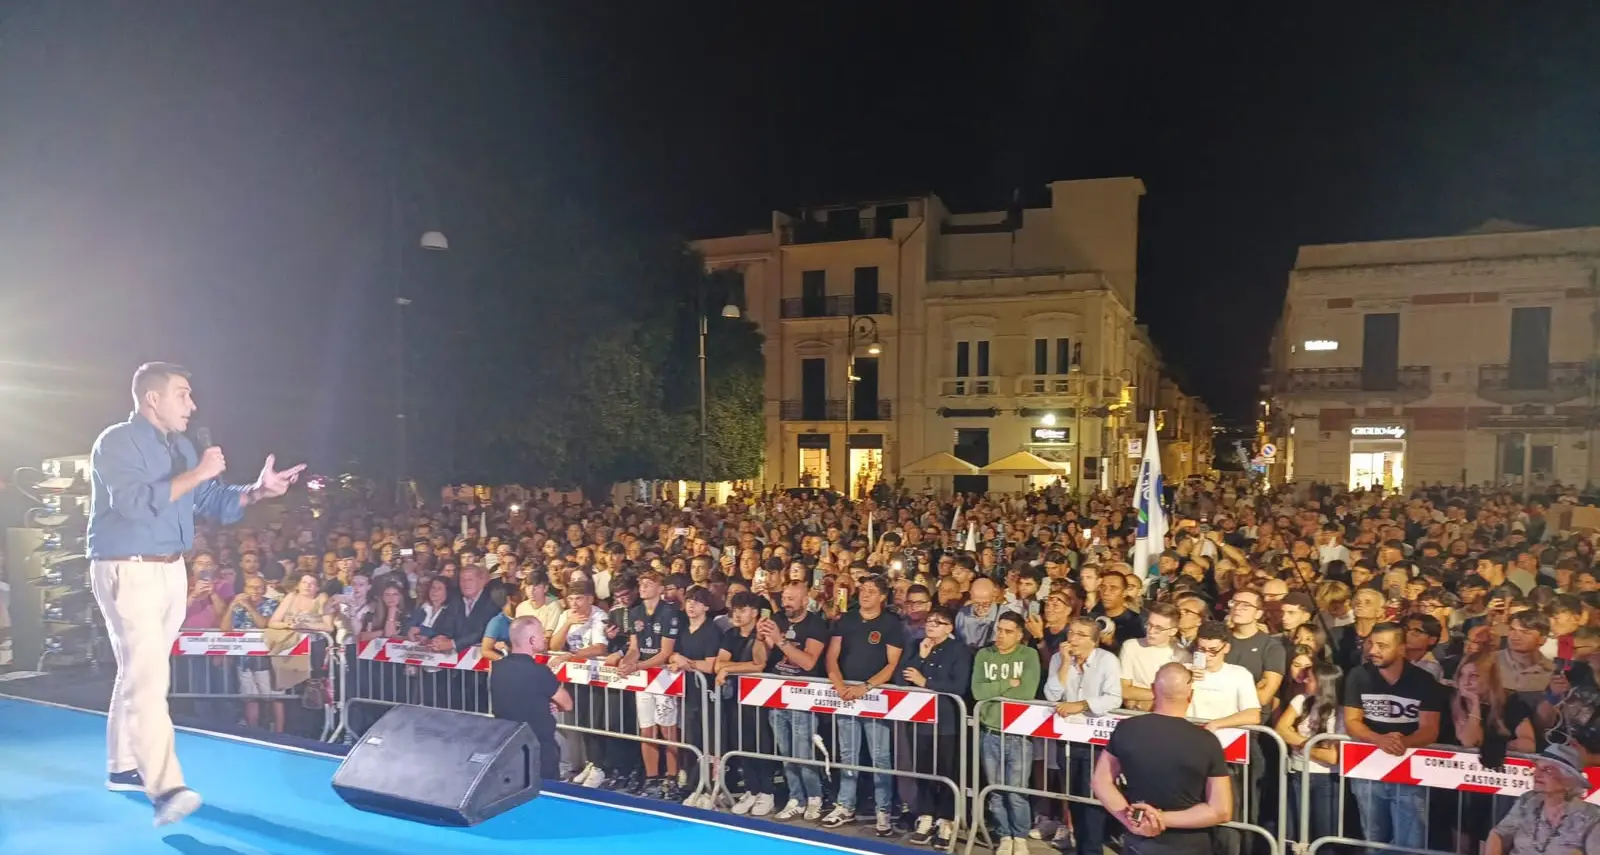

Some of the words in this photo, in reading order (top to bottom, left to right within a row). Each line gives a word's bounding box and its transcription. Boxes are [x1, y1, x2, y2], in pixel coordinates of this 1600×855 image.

[984, 661, 1024, 681] ICON
[790, 686, 815, 697] COMUNE
[814, 698, 841, 708] CASTORE
[1388, 700, 1419, 719] DS
[1424, 757, 1465, 770] COMUNE
[1468, 761, 1478, 771] di
[1464, 773, 1508, 787] CASTORE
[1512, 778, 1531, 790] SPL
